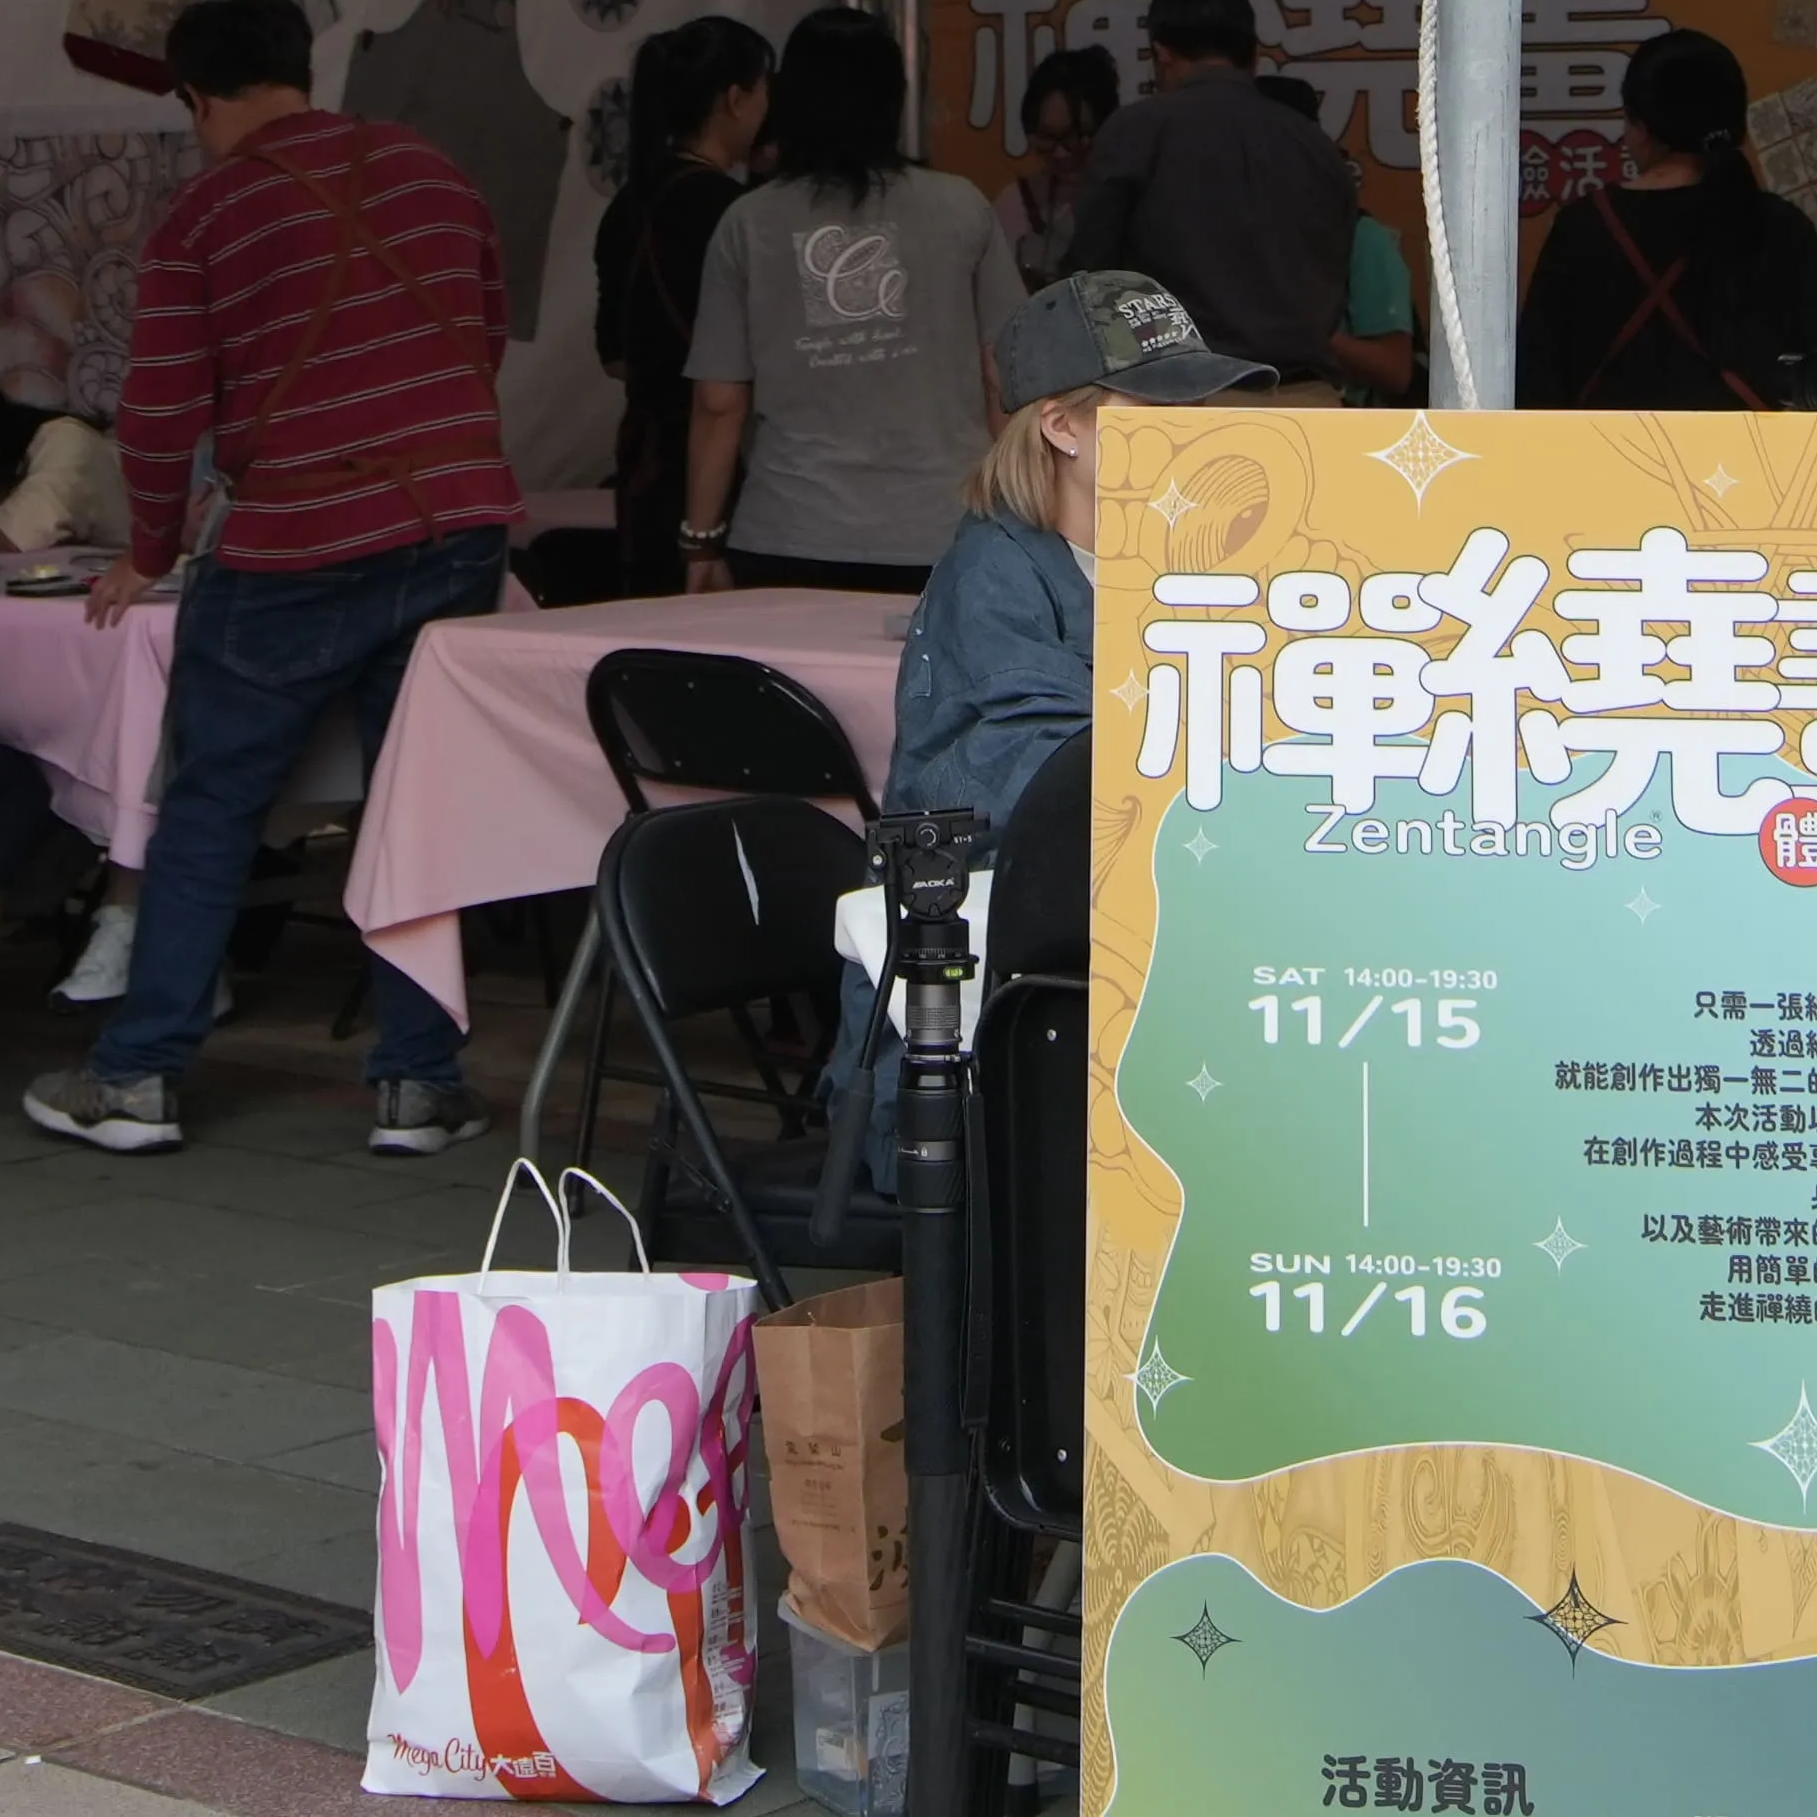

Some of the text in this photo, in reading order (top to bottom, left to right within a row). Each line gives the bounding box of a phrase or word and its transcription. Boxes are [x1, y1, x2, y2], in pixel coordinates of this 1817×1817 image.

[1252, 965, 1498, 990] SAT 14:00-19:30
[1248, 994, 1481, 1049] 11/15
[1249, 1252, 1503, 1279] SUN 14:00-19:30
[1249, 1281, 1487, 1339] 11/16
[386, 1732, 487, 1782] Mega City
[1320, 1752, 1535, 1817] 活動資訊
